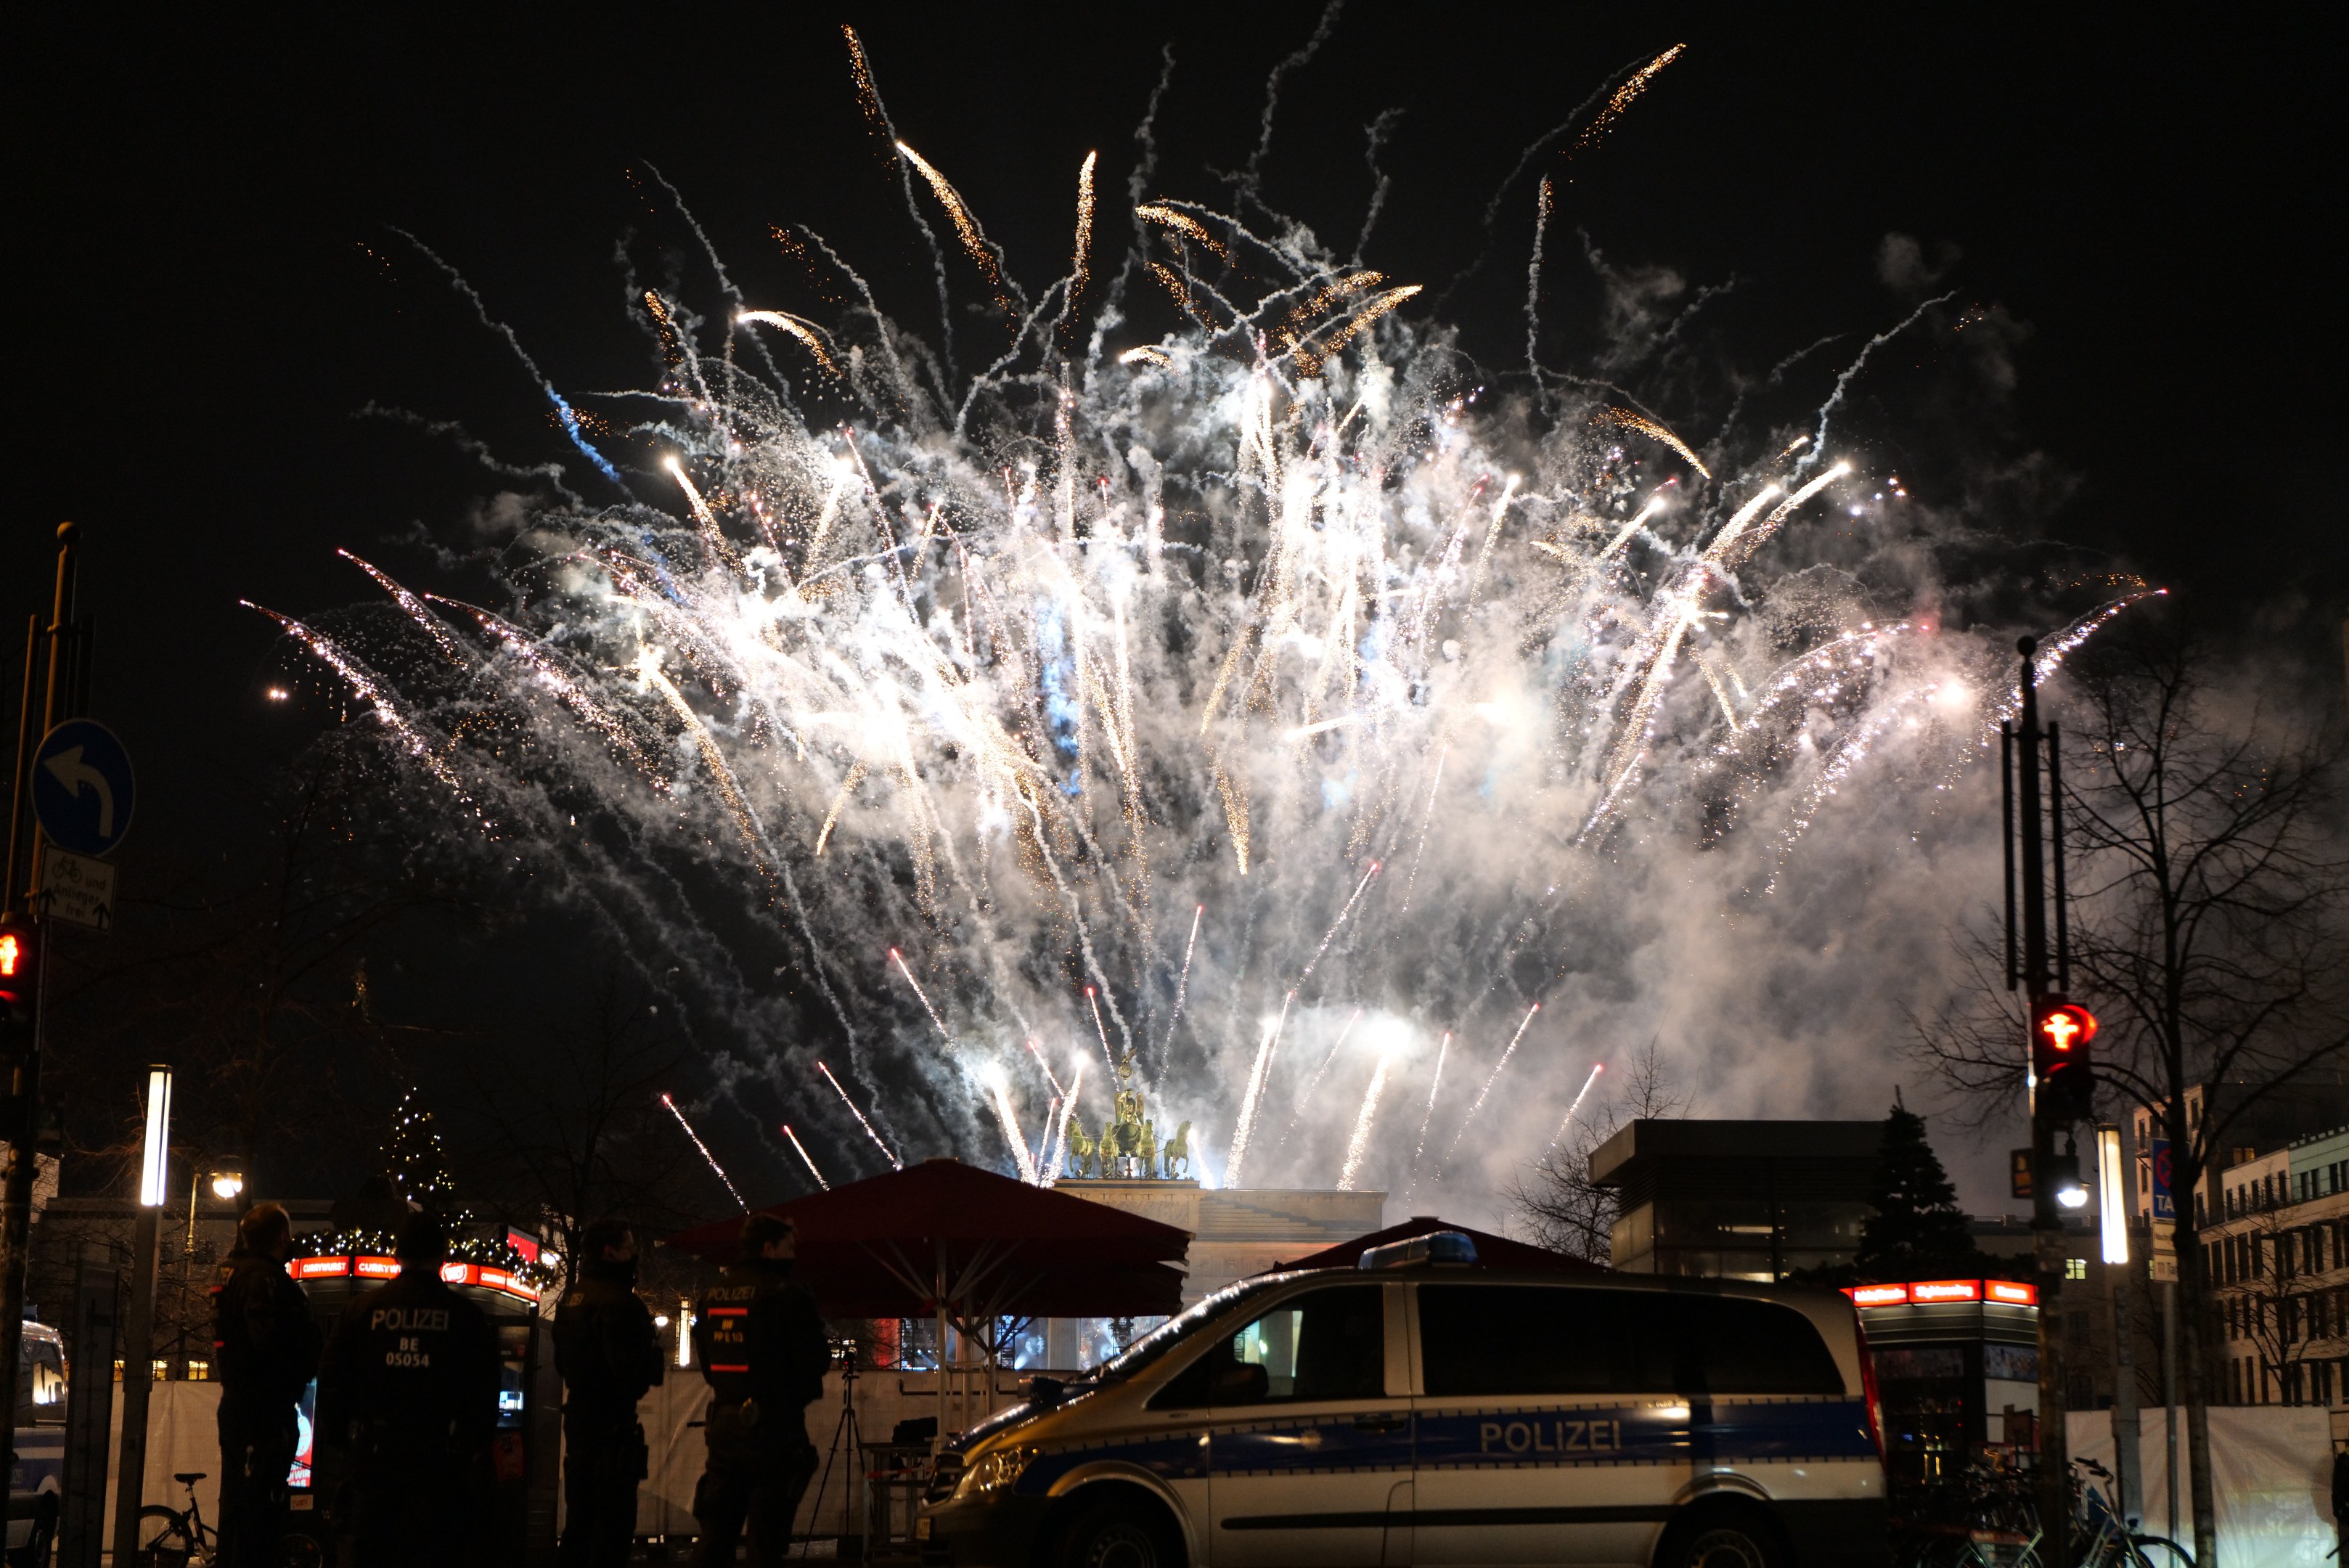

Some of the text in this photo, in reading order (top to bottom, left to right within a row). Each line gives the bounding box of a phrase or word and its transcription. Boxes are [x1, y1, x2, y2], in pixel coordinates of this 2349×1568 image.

[86, 878, 106, 891] und
[2155, 1195, 2176, 1213] TA
[303, 1262, 347, 1273] CURRYWURST
[706, 1285, 756, 1302] POLIZEI
[371, 1307, 450, 1331] POLIZEI
[399, 1336, 420, 1352] BE
[1479, 1420, 1622, 1453] POLIZEI
